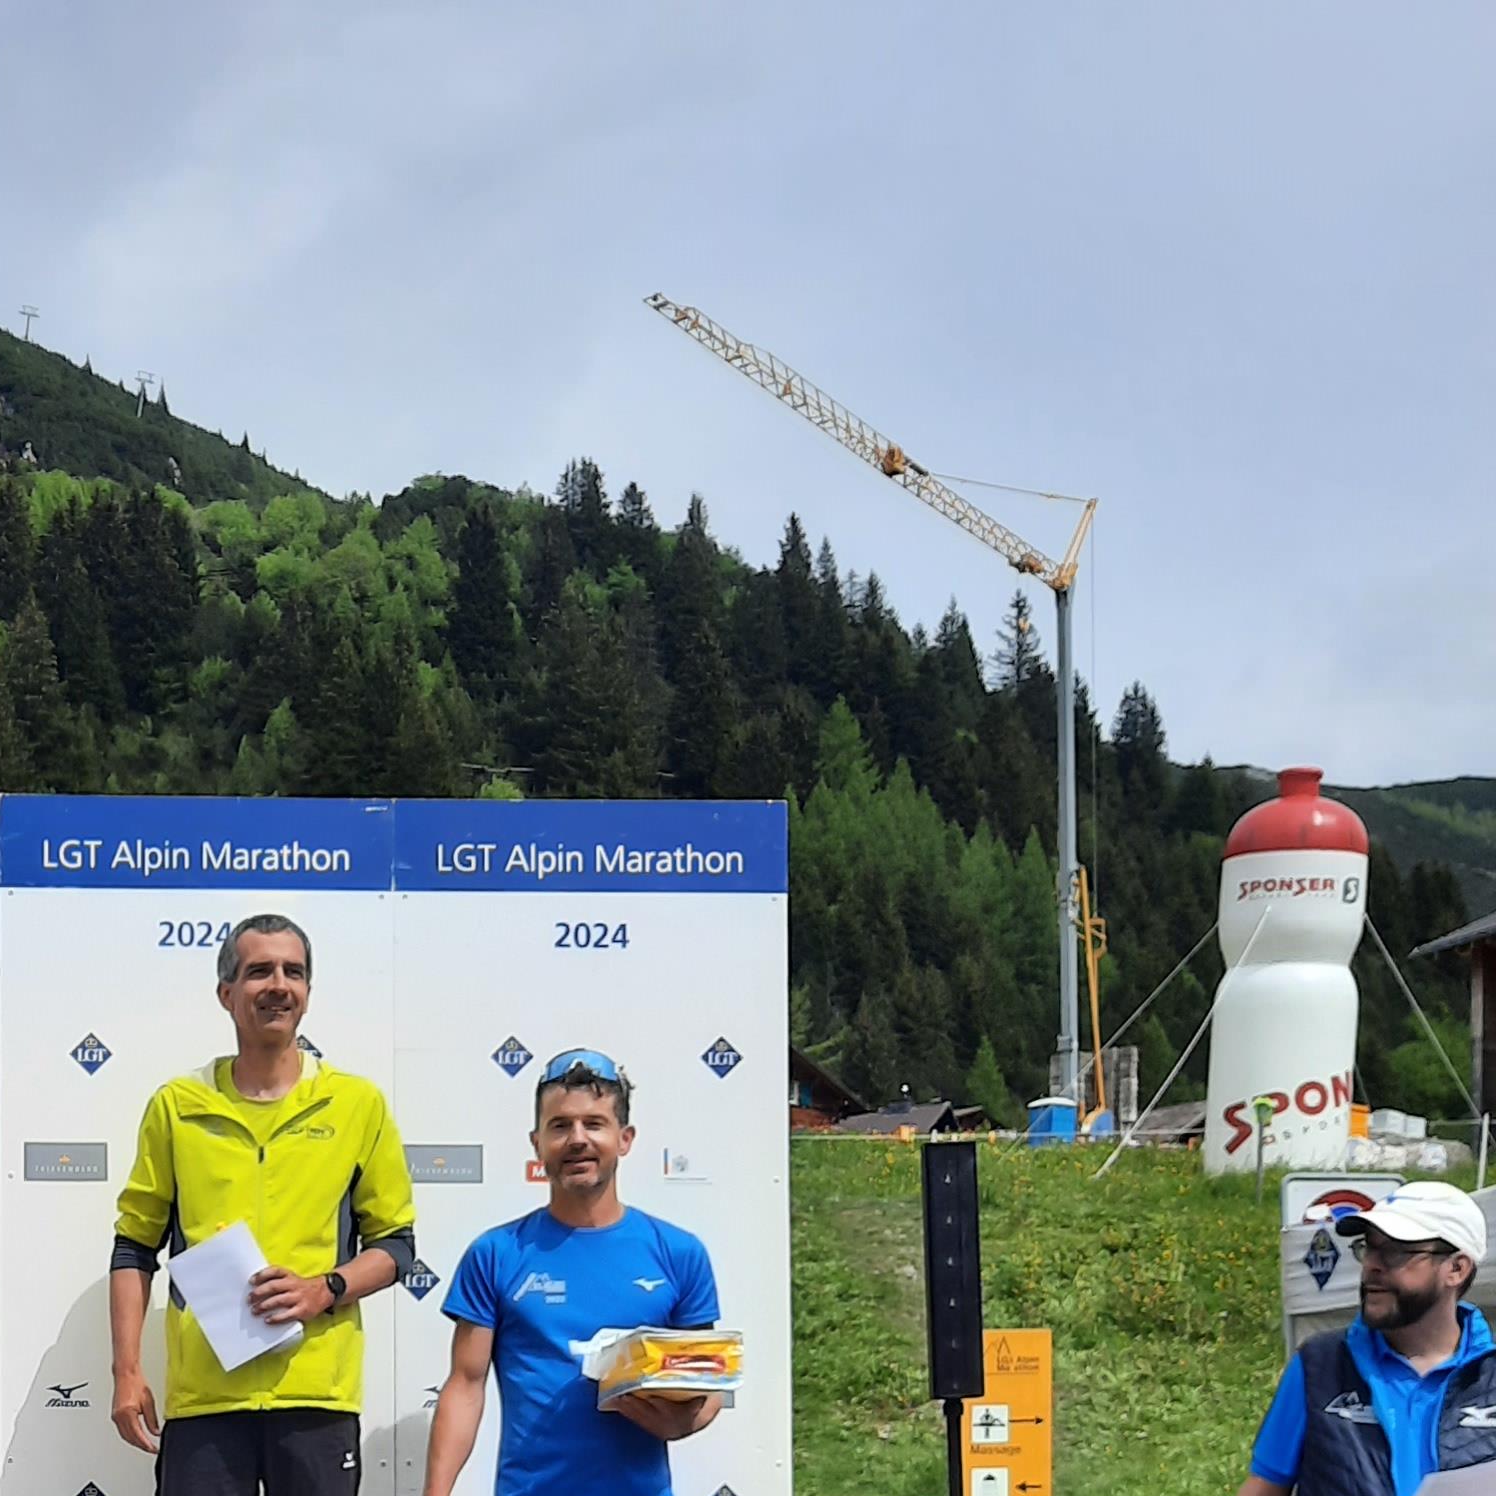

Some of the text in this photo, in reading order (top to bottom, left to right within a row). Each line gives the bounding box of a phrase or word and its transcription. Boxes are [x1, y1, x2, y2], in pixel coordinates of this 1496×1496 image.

[42, 839, 351, 876] LGT Alpin Marathon
[437, 843, 744, 879] LGT Alpin Marathon
[1237, 877, 1335, 901] SPONSER
[554, 922, 630, 948] 2024
[77, 1047, 107, 1062] LGT
[498, 1051, 527, 1066] LGT
[708, 1051, 738, 1066] LGT
[405, 1272, 434, 1288] LGT
[970, 1445, 1021, 1455] Massage
